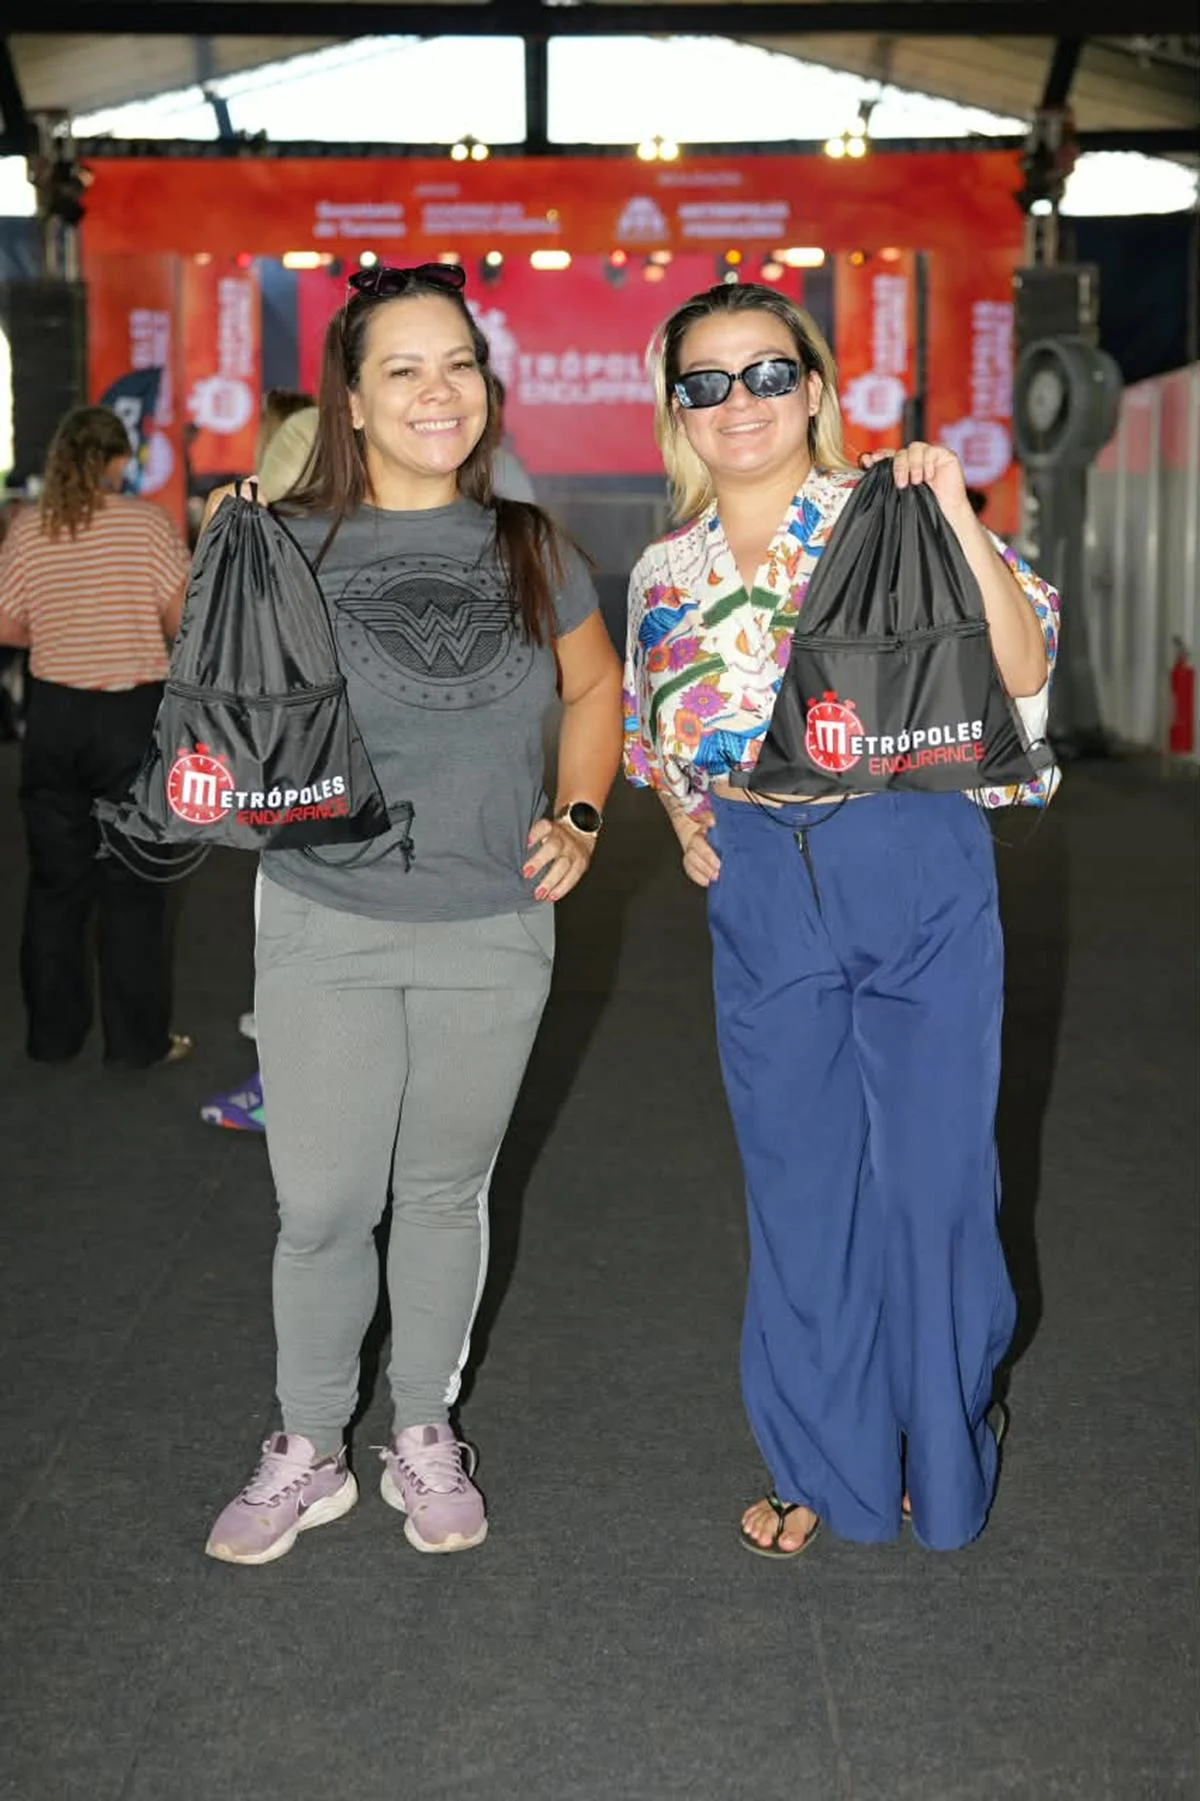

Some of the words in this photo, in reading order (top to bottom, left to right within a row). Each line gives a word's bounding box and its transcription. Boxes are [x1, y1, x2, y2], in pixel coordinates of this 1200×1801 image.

[815, 719, 984, 756] METRÓPOLES
[868, 741, 986, 776] ENDURANCE
[181, 769, 346, 809] METRÓPOLES
[236, 796, 350, 826] ENDURANCE
